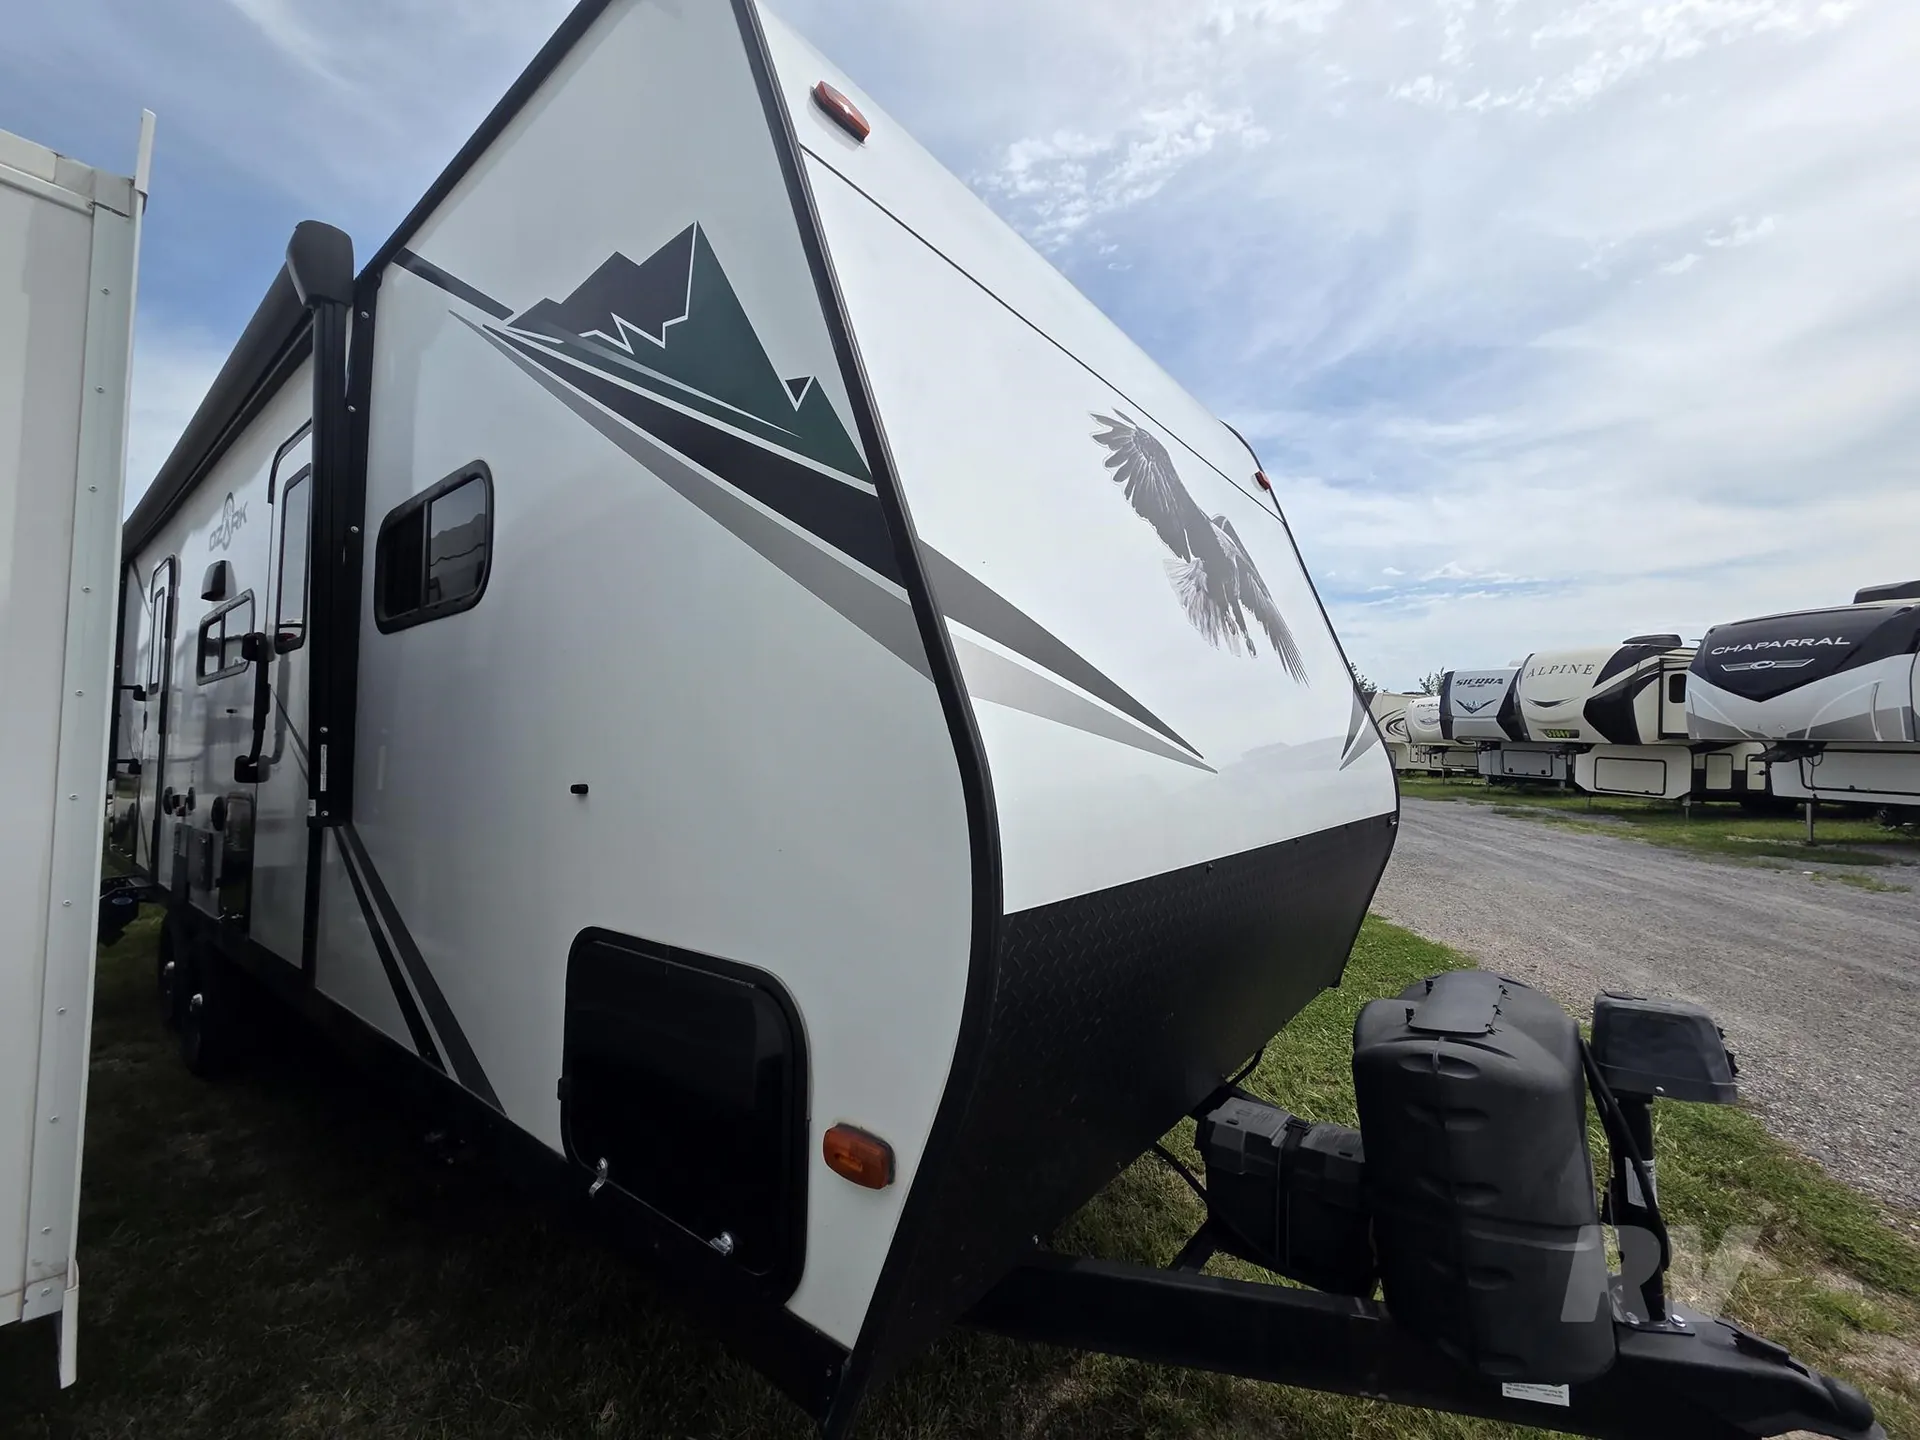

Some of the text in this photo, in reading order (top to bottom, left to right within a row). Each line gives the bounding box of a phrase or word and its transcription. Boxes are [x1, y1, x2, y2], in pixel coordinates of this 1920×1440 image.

[1711, 637, 1851, 655] CHAPARRAL
[1526, 663, 1595, 679] ALPINE
[1455, 678, 1504, 686] SIERRA
